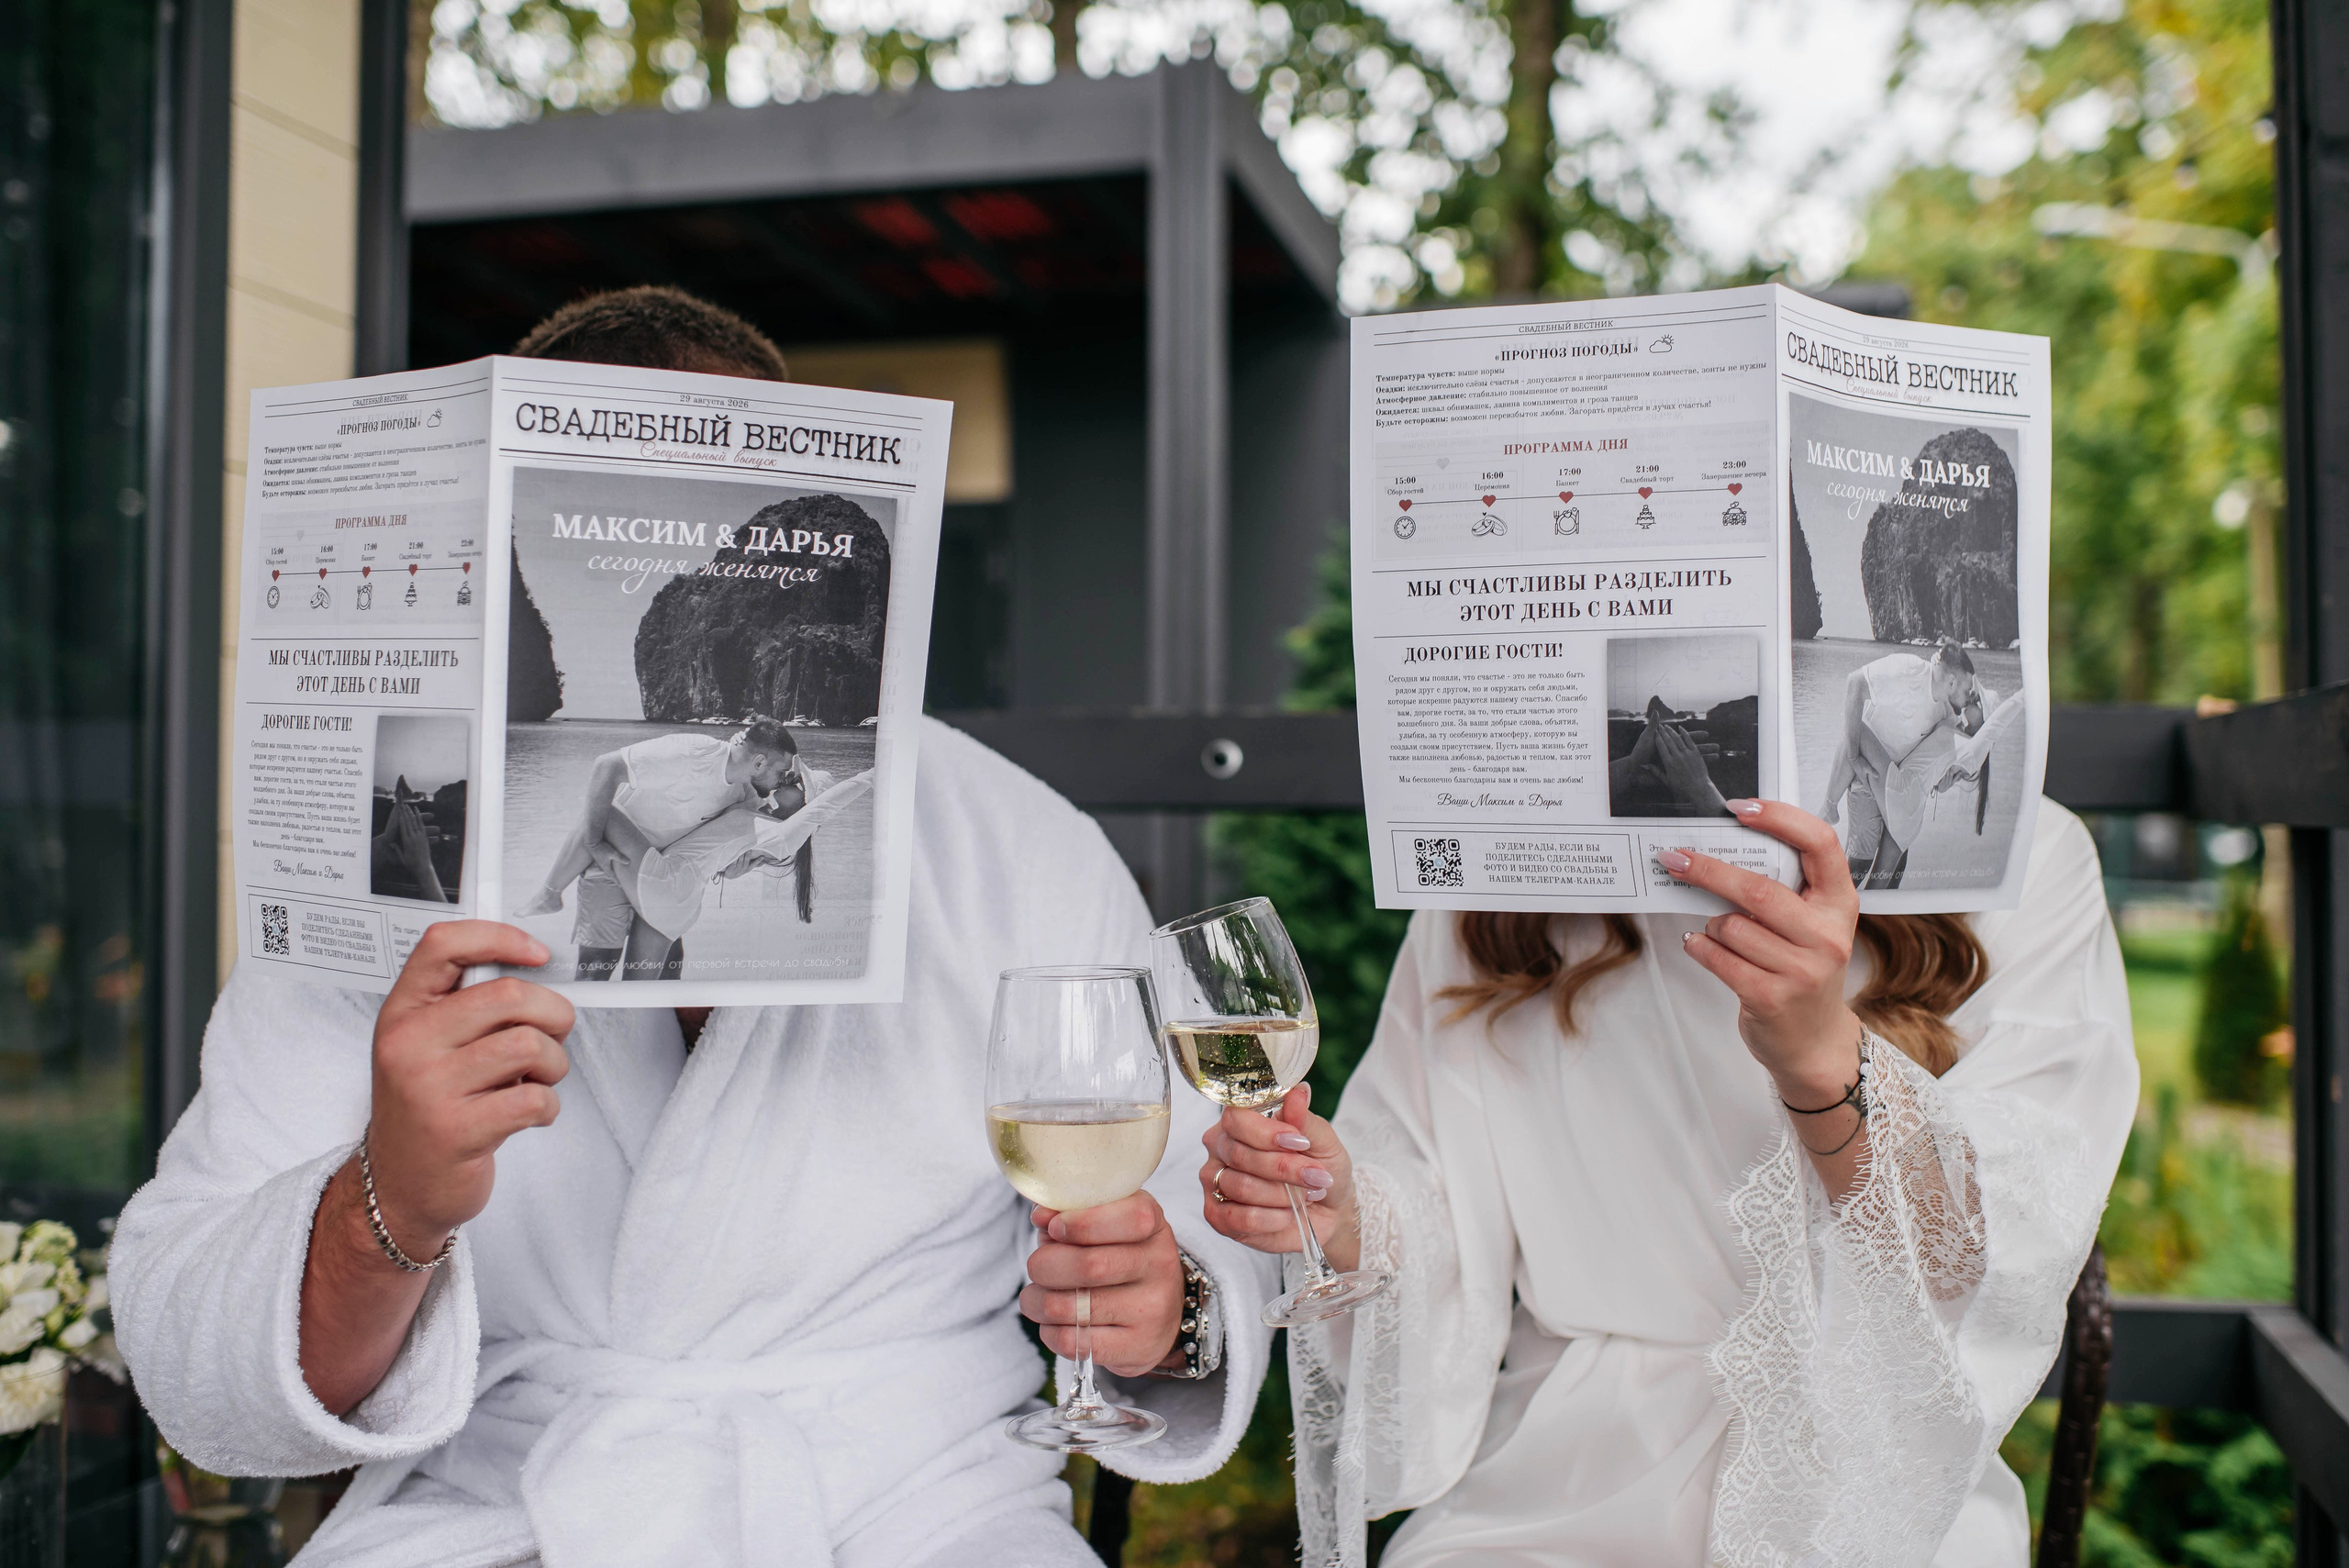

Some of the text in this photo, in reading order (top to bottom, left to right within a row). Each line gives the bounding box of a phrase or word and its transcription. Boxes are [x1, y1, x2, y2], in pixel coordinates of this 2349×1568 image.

[1519, 320, 1614, 333] СВАДЕБНЫЙ ВЕСТНИК
[1495, 342, 1639, 361] «ПРОГНОЗ ПОГОДЫ»
[1787, 331, 2018, 396] СВАДЕБНЫЙ ВЕСТНИК
[1375, 373, 1426, 383] Температура
[1427, 371, 1456, 381] чувств:
[1480, 368, 1505, 377] нормы
[1375, 385, 1406, 395] Осадки:
[1407, 382, 1464, 392] исключительно
[1465, 380, 1487, 388] слёзы
[1526, 375, 1576, 385] допускаются
[1586, 371, 1651, 382] неограниченном
[1653, 368, 1699, 377] количестве,
[1739, 362, 1766, 373] нужны
[1375, 395, 1427, 405] Атмосферное
[1428, 393, 1466, 402] давление:
[1468, 390, 1508, 399] стабильно
[1509, 387, 1558, 396] повышенное
[1571, 384, 1608, 393] волнения
[1846, 377, 1932, 406] Специальный выпуск
[353, 394, 408, 406] СВАДЕБНЫЙ ВЕСТНИК
[680, 395, 749, 408] 29 августа 2026
[1375, 407, 1419, 417] Ожидается:
[1421, 406, 1445, 414] шквал
[1446, 403, 1492, 412] обнимашек,
[1493, 401, 1520, 409] лавина
[1522, 398, 1578, 407] комплиментов
[1587, 396, 1609, 406] гроза
[1375, 418, 1402, 428] Будьте
[1404, 417, 1449, 426] осторожны:
[1451, 414, 1487, 422] возможен
[1489, 410, 1539, 421] переизбыток
[1540, 408, 1567, 417] любви.
[1569, 406, 1606, 417] Загорать
[1607, 405, 1643, 415] придётся
[1652, 403, 1676, 413] лучах
[1678, 399, 1711, 409] счастья!
[517, 403, 901, 464] СВАДЕБНЫЙ ВЕСТНИК
[640, 440, 776, 469] Специальный выпуск
[1504, 438, 1629, 456] ПРОГРАММА ДНЯ
[1635, 464, 1660, 473] 21:00
[1722, 460, 1747, 470] 23:00
[1808, 439, 1991, 487] МАКСИМ & ДАРЬЯ
[1482, 471, 1504, 480] 16:00
[1559, 467, 1582, 476] 17:00
[1701, 473, 1743, 482] Завершение
[1395, 476, 1417, 485] 15:00
[1555, 479, 1580, 487] Банкет
[1620, 475, 1657, 484] Свадебный
[1386, 488, 1403, 496] Сбор
[1475, 484, 1510, 492] Церемония
[1828, 480, 1971, 519] сегодня женятся
[335, 514, 407, 528] ПРОГРАММА ДНЯ
[552, 514, 854, 558] МАКСИМ & ДАРЬЯ
[588, 552, 822, 594] сегодня женятся
[1407, 569, 1732, 597] МЫ СЧАСТЛИВЫ РАЗДЕЛИТЬ
[1460, 598, 1673, 624] ЭТОТ ДЕНЬ С ВАМИ
[269, 651, 459, 669] МЫ СЧАСТЛИВЫ РАЗДЕЛИТЬ
[1404, 642, 1563, 665] ДОРОГИЕ ГОСТИ!
[1388, 674, 1418, 684] Сегодня
[1565, 670, 1586, 679] быть
[296, 676, 419, 695] ЭТОТ ДЕНЬ С ВАМИ
[262, 714, 351, 730] ДОРОГИЕ ГОСТИ!
[1438, 793, 1469, 806] Ваши
[1471, 794, 1515, 807] Максим
[1529, 794, 1563, 809] Дарья
[1495, 841, 1600, 852] БУДЕМ РАДЫ, ЕСЛИ ВЫ
[1485, 852, 1613, 863] ПОДЕЛИТЕСЬ СДЕЛАННЫМИ
[1483, 863, 1618, 874] ФОТО И ВИДЕО СО СВАДЬБЫ В
[1488, 874, 1616, 885] НАШЕМ ТЕЛЕГРАМ-КАНАЛЕ
[579, 960, 618, 970] одной
[669, 960, 683, 969] от
[687, 959, 729, 971] первой
[735, 959, 780, 970] встречи
[785, 960, 799, 968] до
[804, 956, 849, 967] свадьбы
